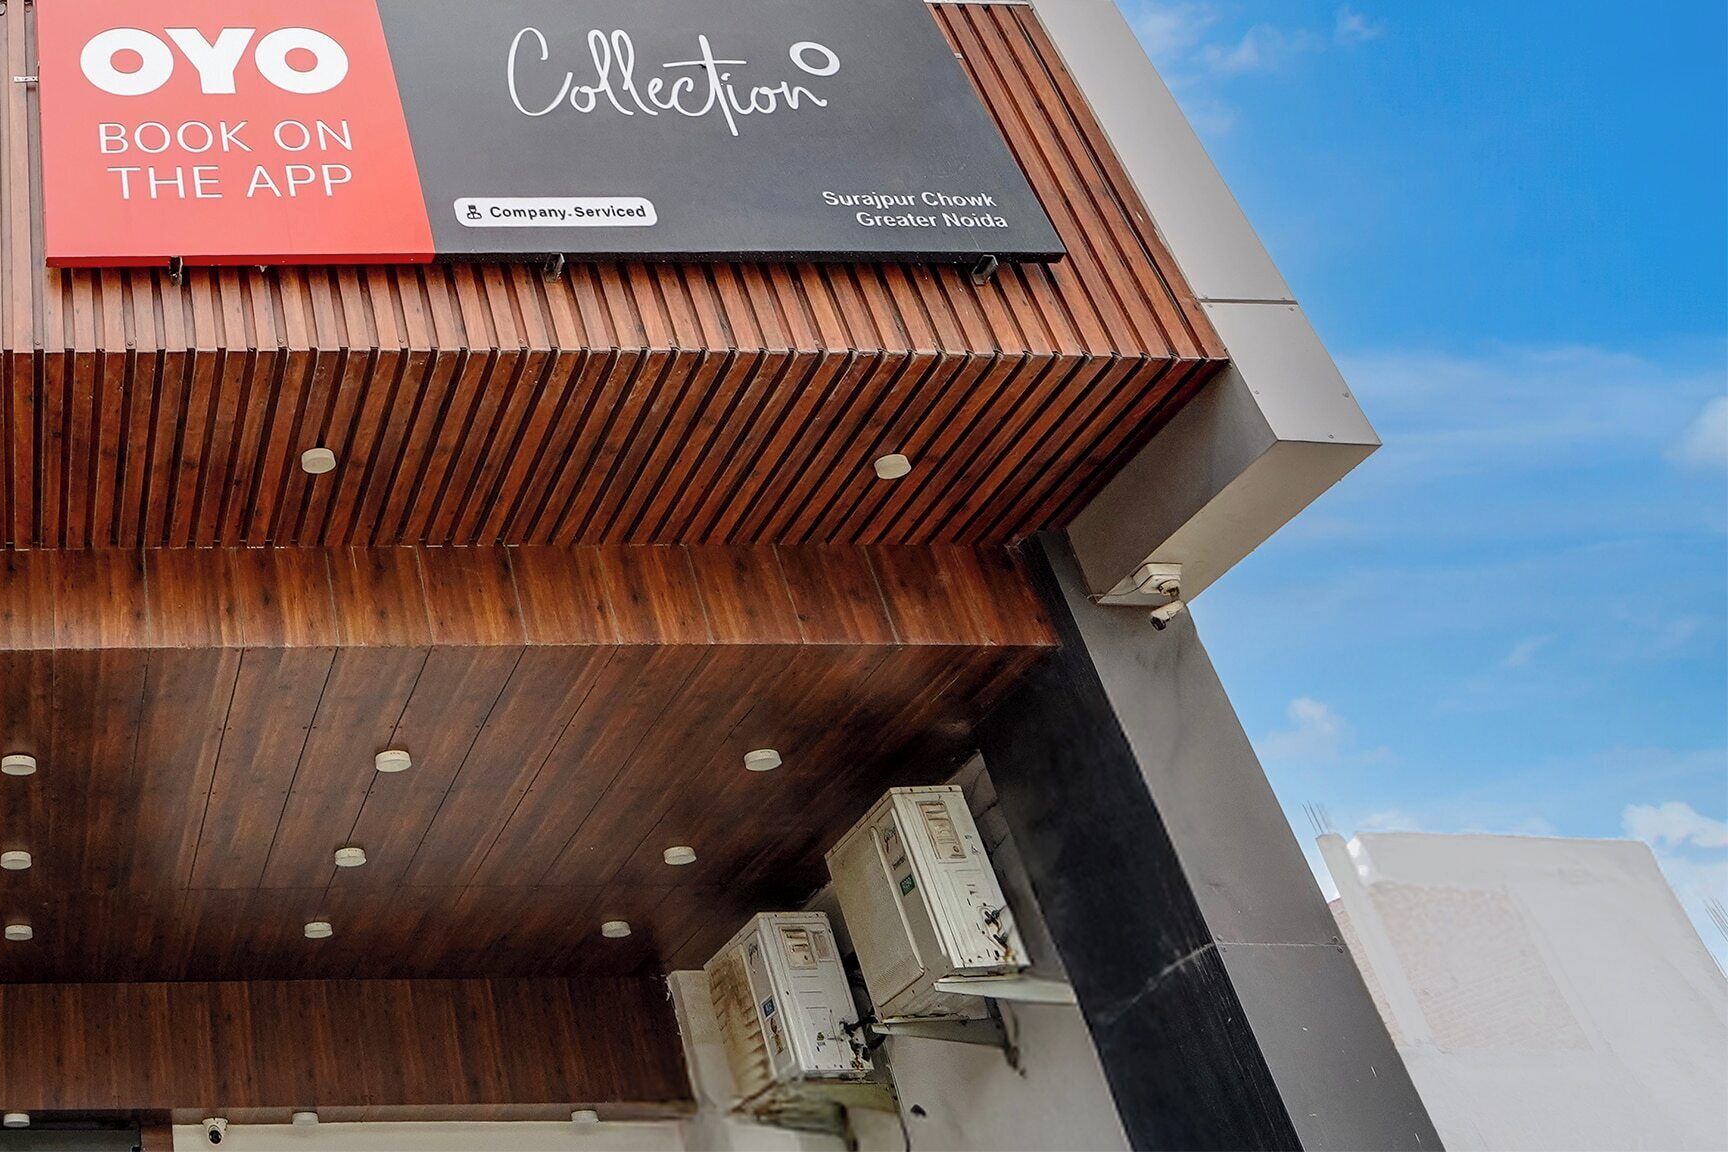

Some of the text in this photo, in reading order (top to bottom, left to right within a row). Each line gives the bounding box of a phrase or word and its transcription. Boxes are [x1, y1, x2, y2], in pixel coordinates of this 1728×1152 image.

[79, 27, 349, 96] OYO
[507, 27, 828, 137] Collection
[98, 120, 353, 154] BOOK ON
[107, 163, 353, 200] THE APP
[822, 191, 997, 209] Surajpur Chowk
[856, 211, 1009, 228] Greater Noida
